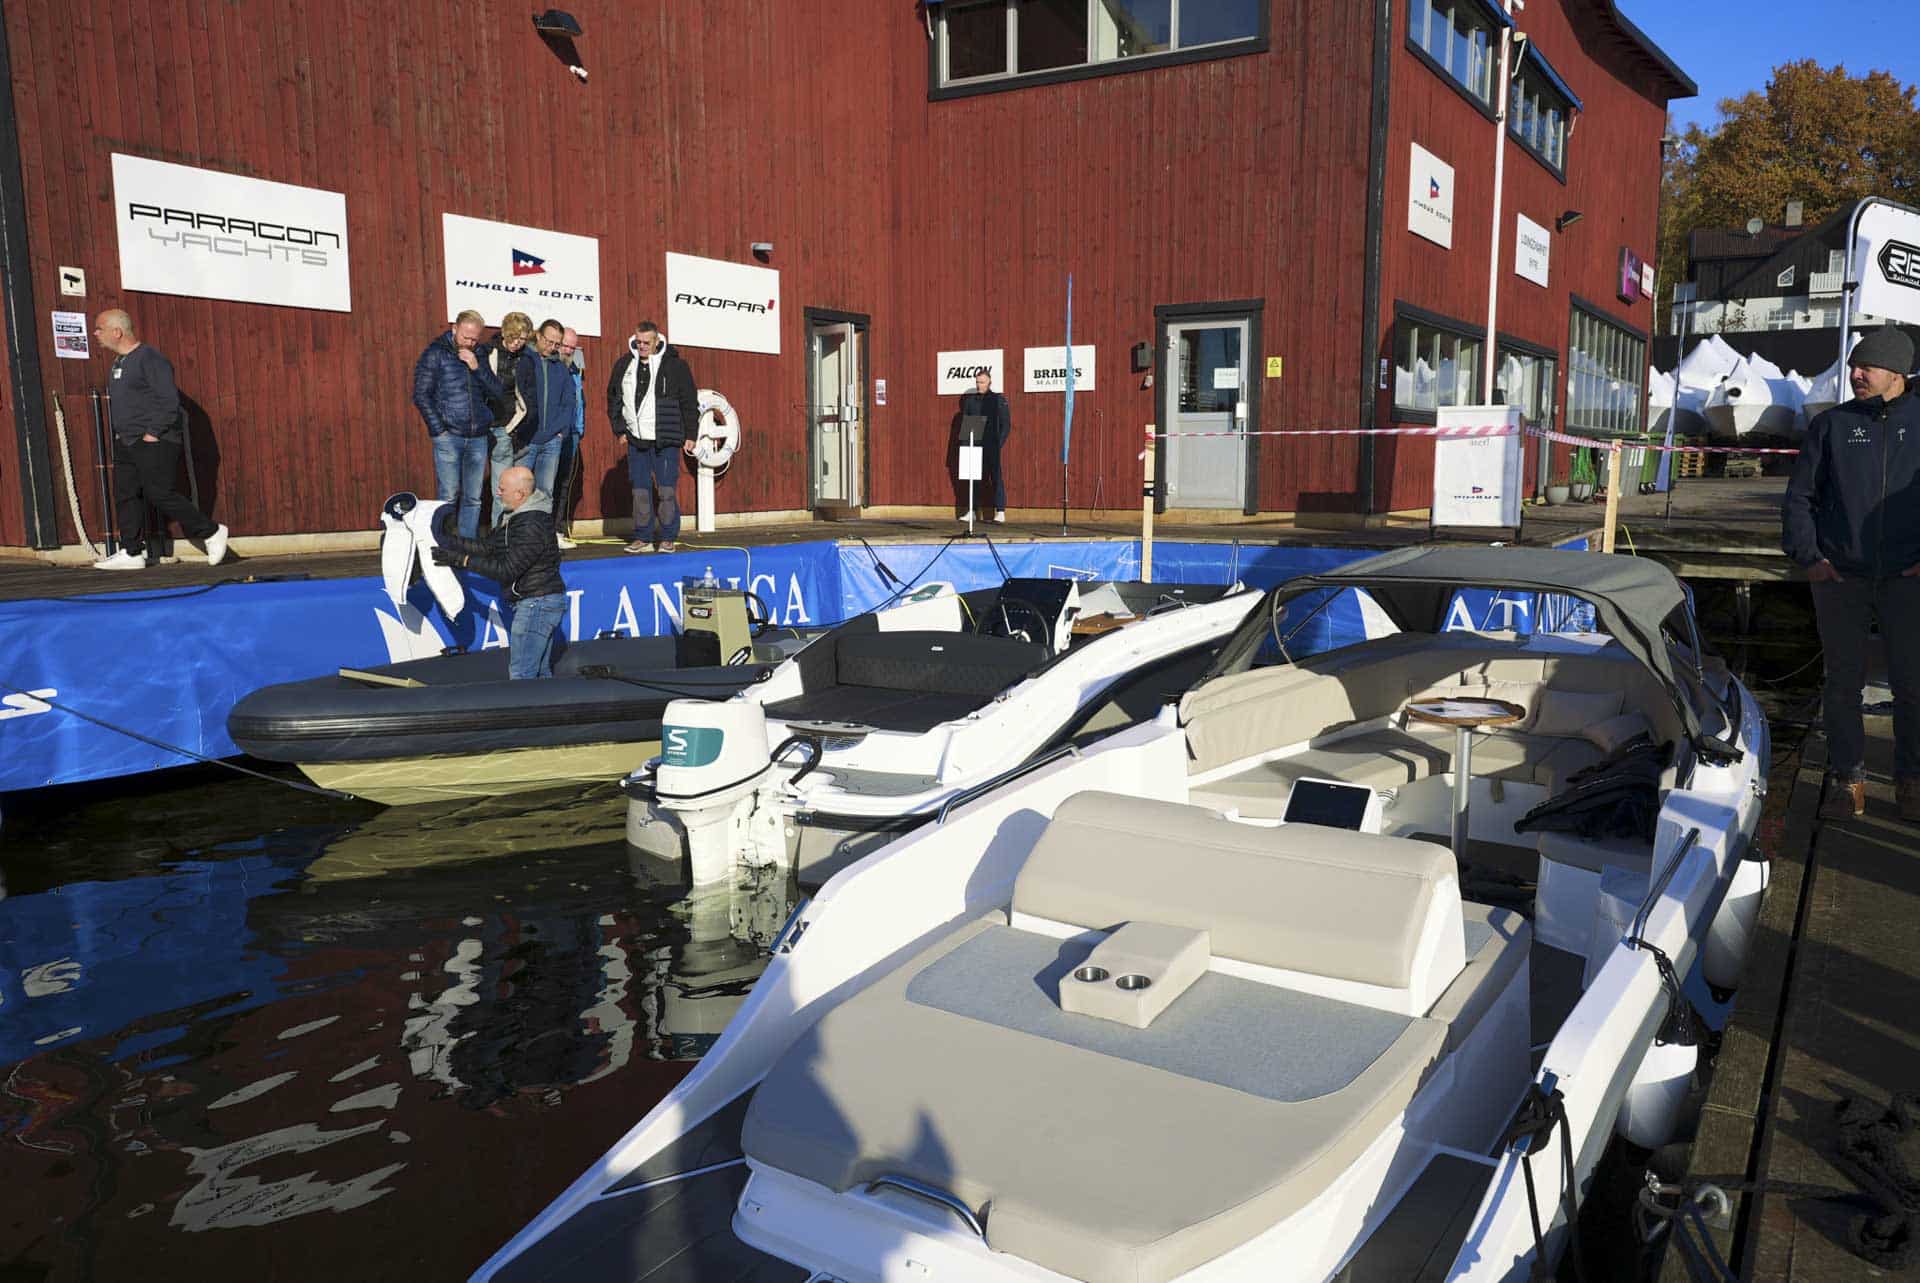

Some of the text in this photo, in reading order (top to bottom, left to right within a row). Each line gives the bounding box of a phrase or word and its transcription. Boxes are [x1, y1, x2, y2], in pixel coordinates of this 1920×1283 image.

[129, 203, 340, 249] PARAGON
[148, 227, 328, 267] YACHTS
[456, 280, 594, 303] NIMBUS BOATS
[675, 293, 766, 314] AXOPAR
[1033, 368, 1082, 379] BRABS
